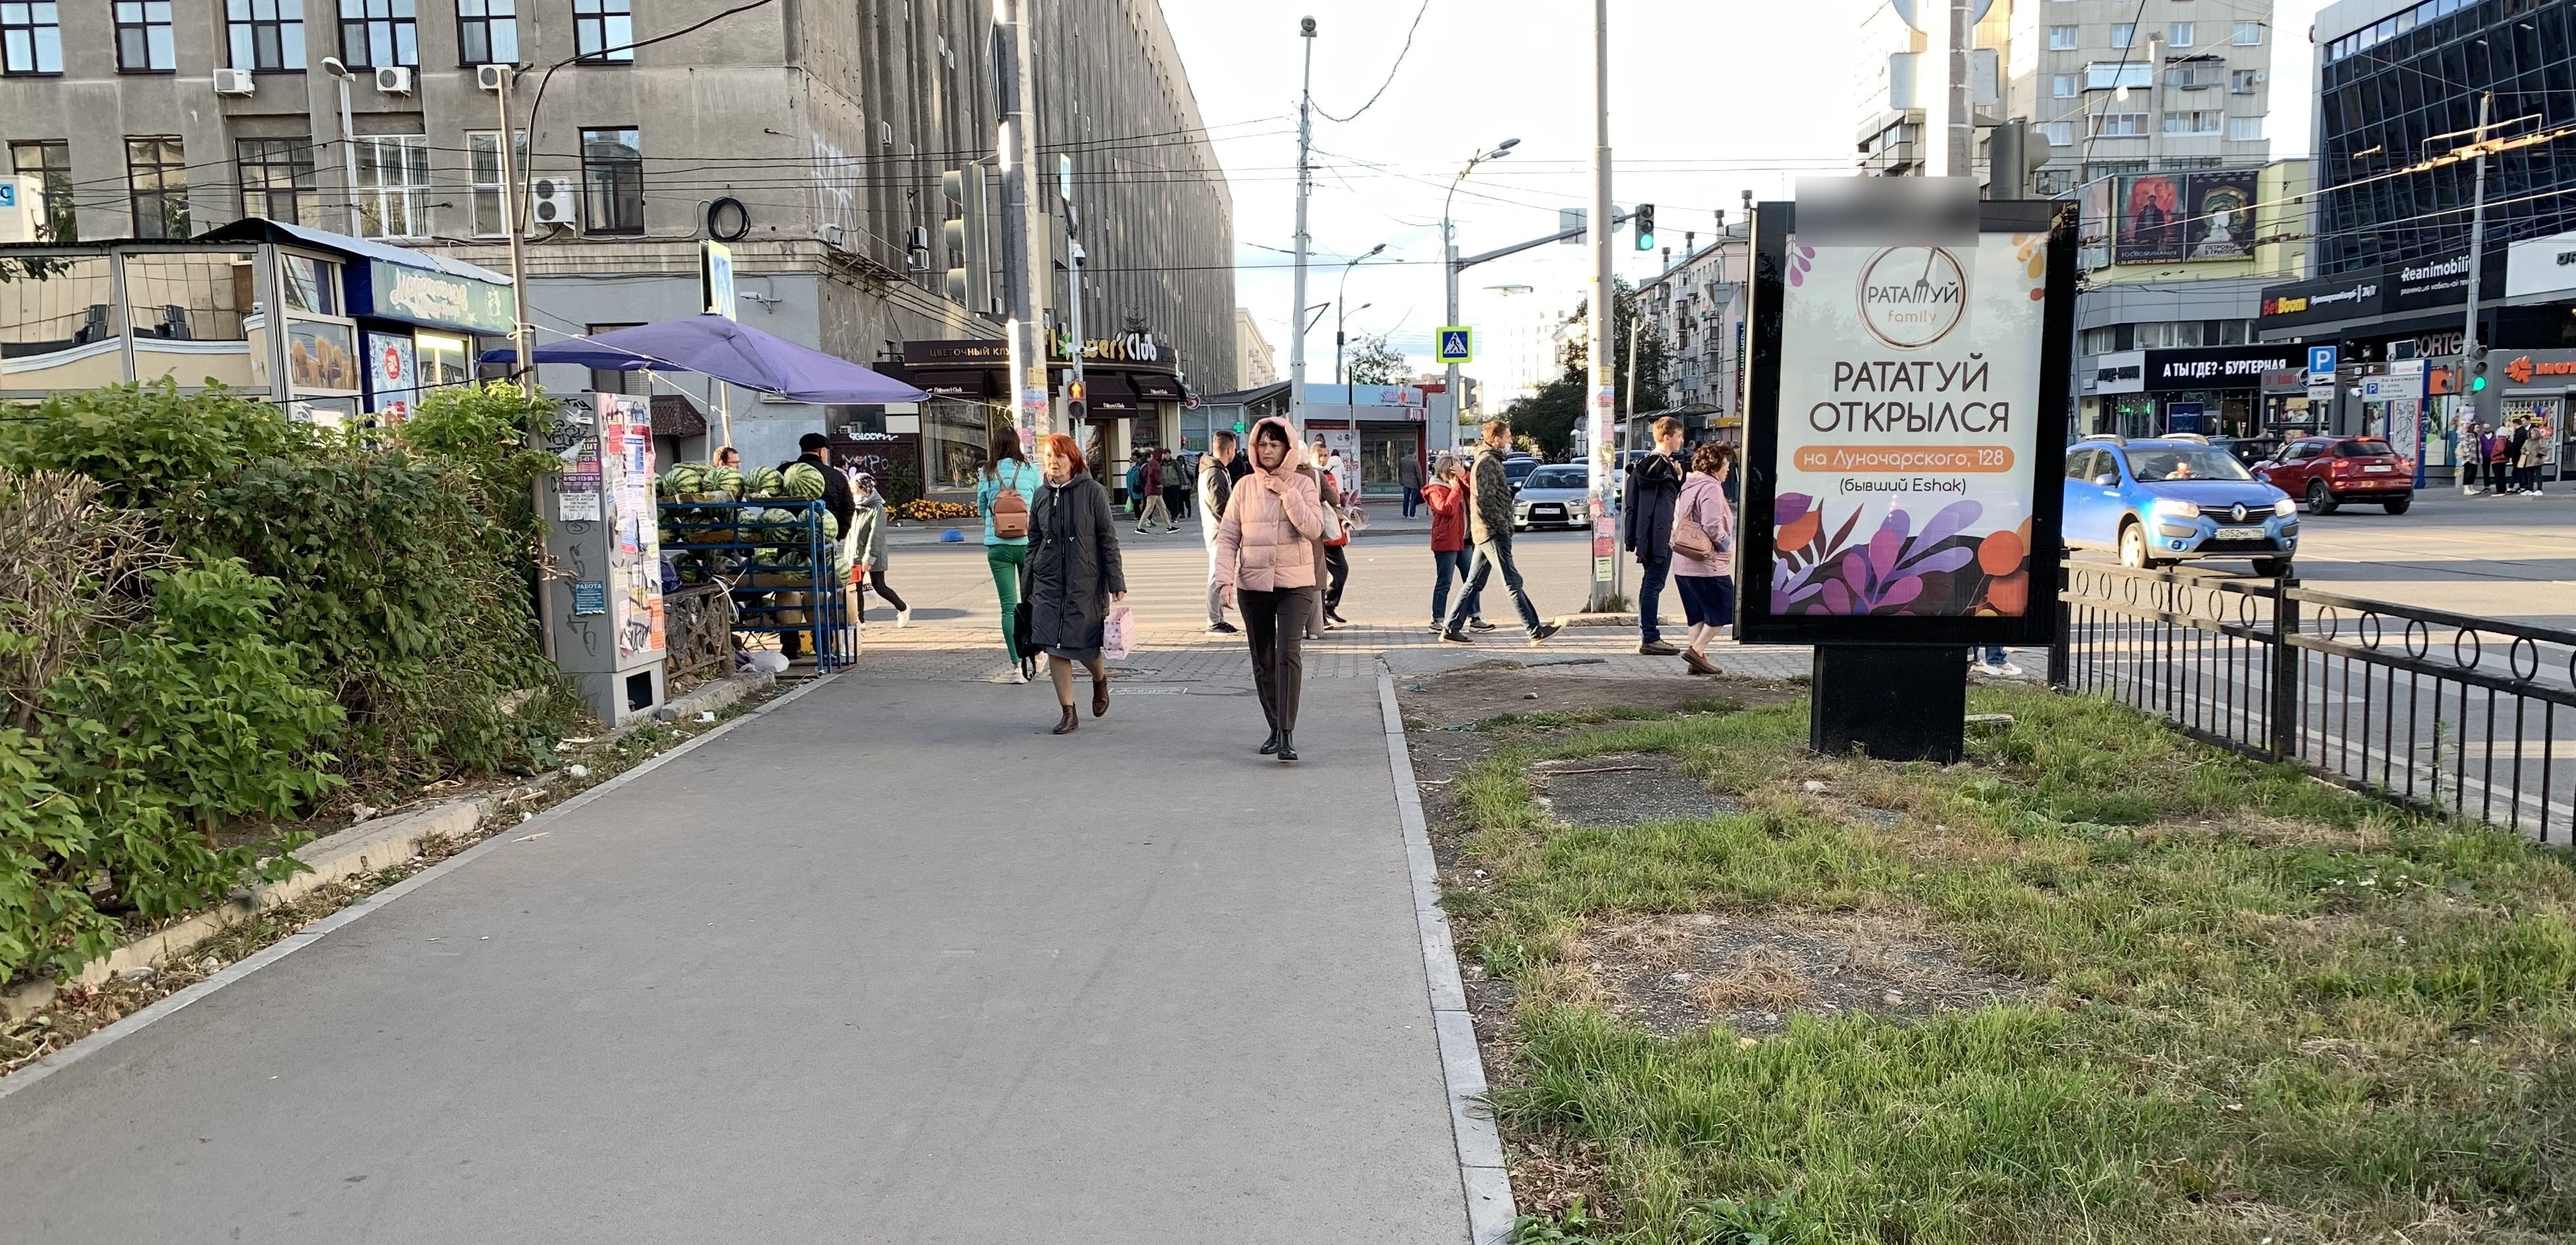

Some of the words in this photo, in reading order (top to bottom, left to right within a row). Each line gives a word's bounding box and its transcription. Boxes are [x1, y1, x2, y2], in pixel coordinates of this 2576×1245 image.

[1868, 281, 1959, 304] РАТАТУЙ
[2263, 297, 2307, 316] BetBoom
[1888, 310, 1937, 325] family
[930, 346, 990, 358] ЦВЕТОЧНЫЙ
[993, 347, 1011, 356] КЛУ
[1127, 333, 1157, 361] Club
[1834, 352, 1988, 392] РАТАТУЙ
[2163, 363, 2171, 377] А
[2173, 362, 2189, 377] ТЫ
[2191, 361, 2217, 379] ГДЕ?
[2225, 358, 2287, 375] БУРГЕРНАЯ
[1810, 402, 2009, 432] ОТКРЫЛСЯ
[1804, 454, 1827, 466] на
[1833, 448, 1972, 470] Луначарского,
[1978, 449, 2004, 466] 128
[1839, 478, 1908, 495] (бывший
[1913, 478, 1967, 495] Eshak)
